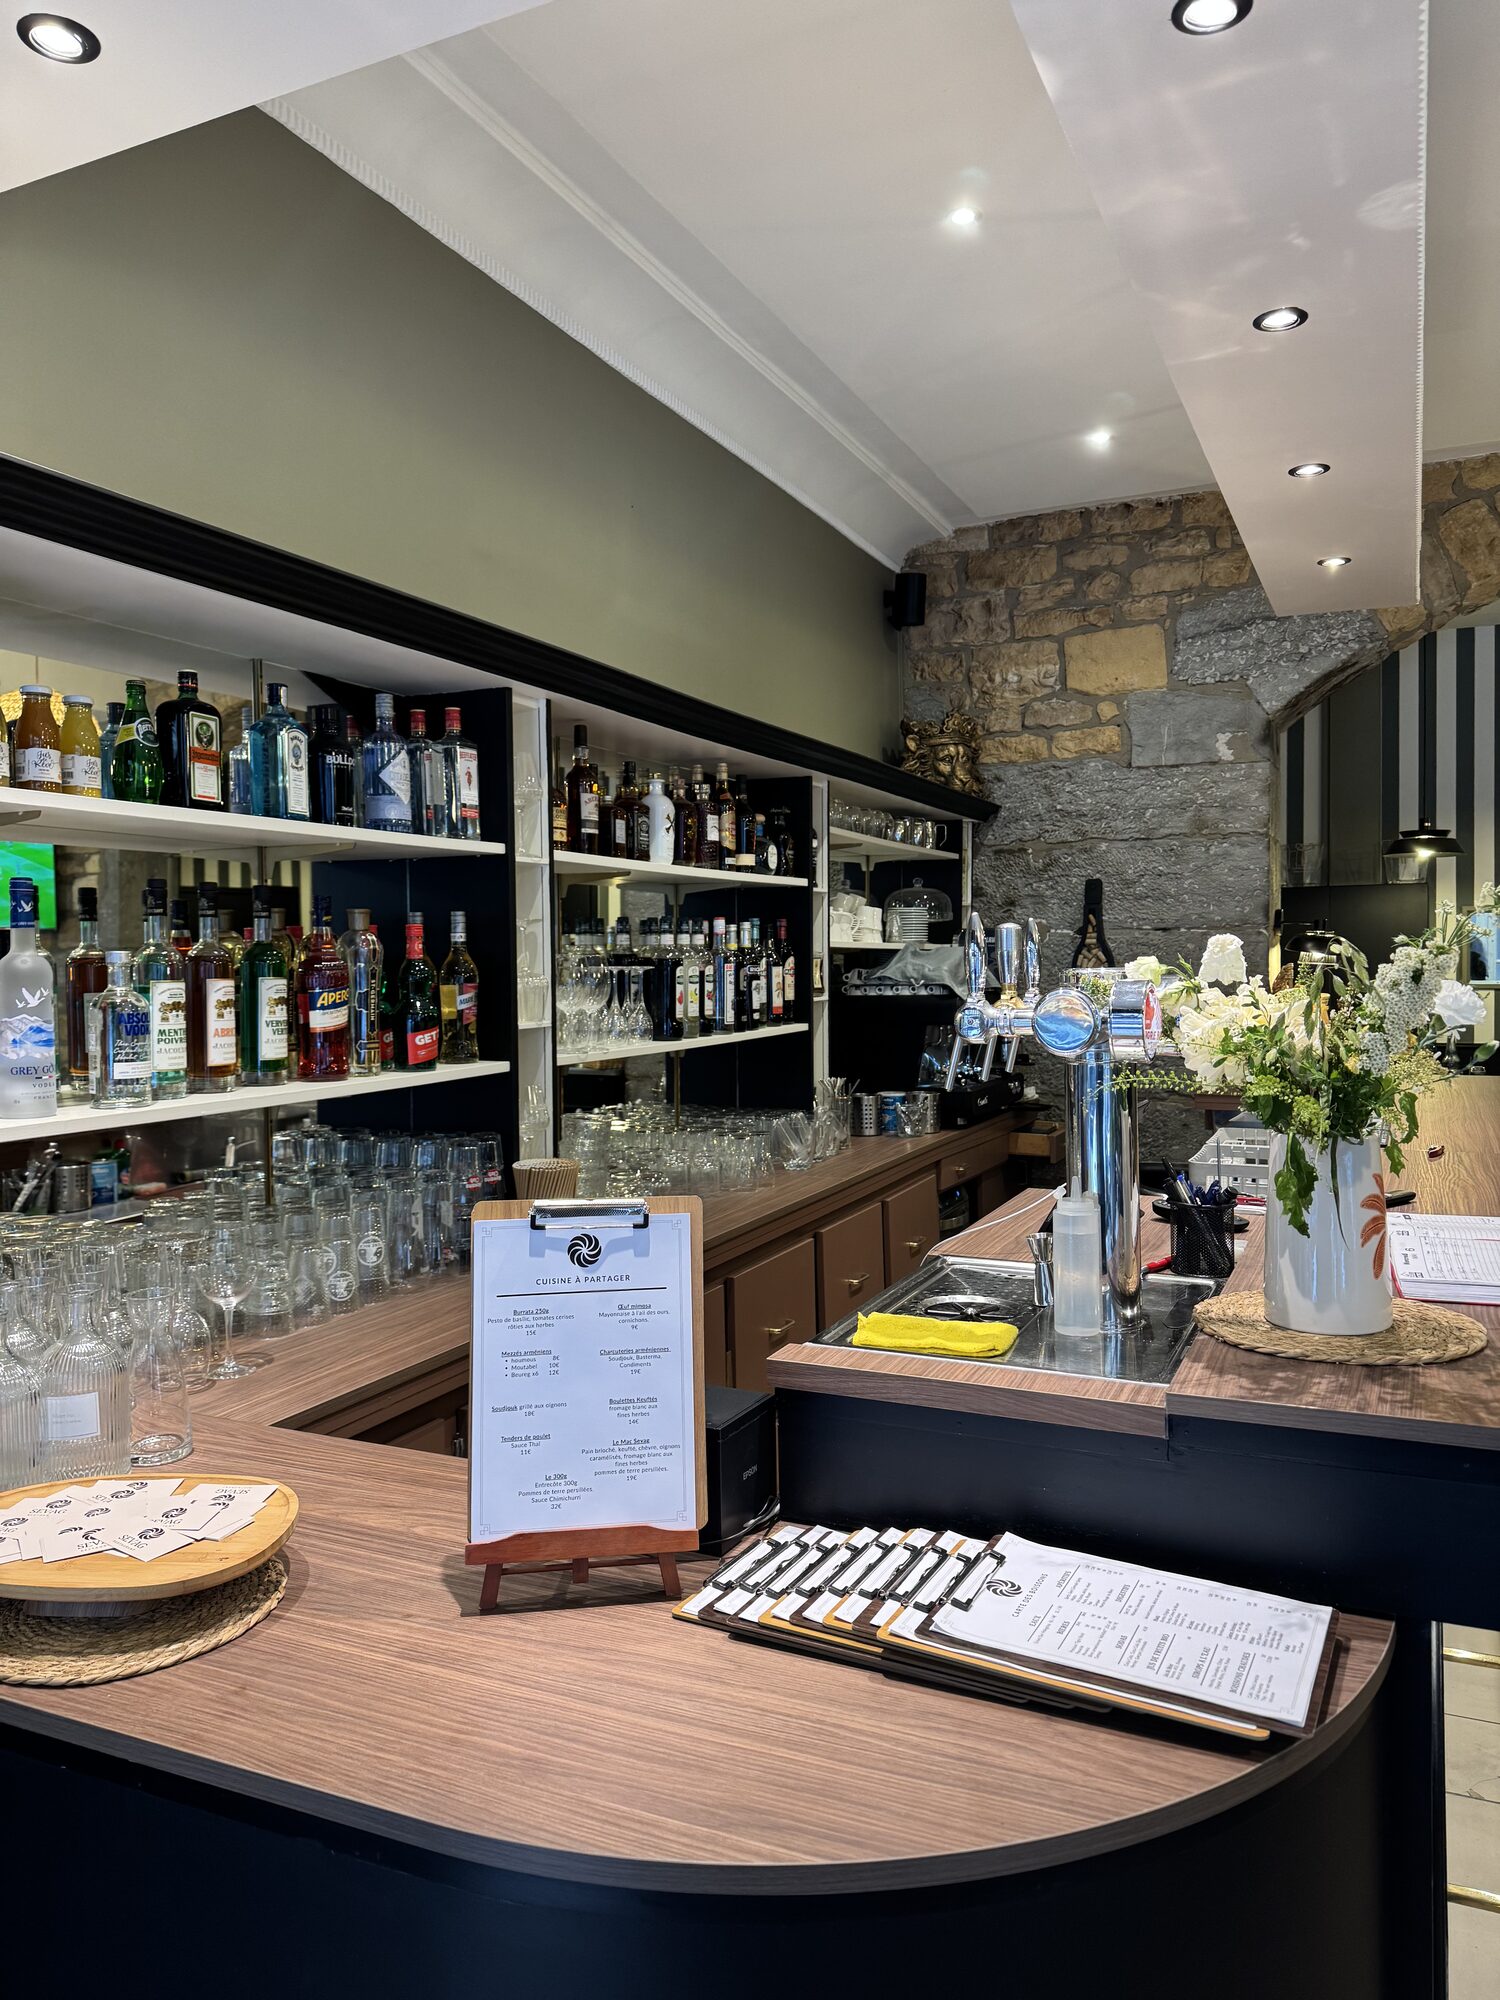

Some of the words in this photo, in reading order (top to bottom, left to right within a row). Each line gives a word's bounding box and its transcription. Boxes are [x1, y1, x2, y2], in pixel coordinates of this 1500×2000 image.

[316, 988, 350, 1008] APERO
[118, 1012, 150, 1024] ABSOL
[10, 1066, 40, 1076] GREY
[536, 1277, 572, 1286] CUISINE
[575, 1274, 581, 1283] À
[585, 1274, 631, 1283] PARTAGER
[519, 1403, 533, 1411] grillé
[501, 1435, 522, 1443] Tenders
[743, 1464, 758, 1480] EPSON
[118, 1535, 148, 1549] SEVAG
[1011, 1601, 1027, 1618] CARTE
[1024, 1591, 1034, 1603] DES
[1031, 1572, 1048, 1593] BOISSONS
[1153, 1639, 1167, 1656] FRUITS
[1229, 1671, 1243, 1695] BOISSONS
